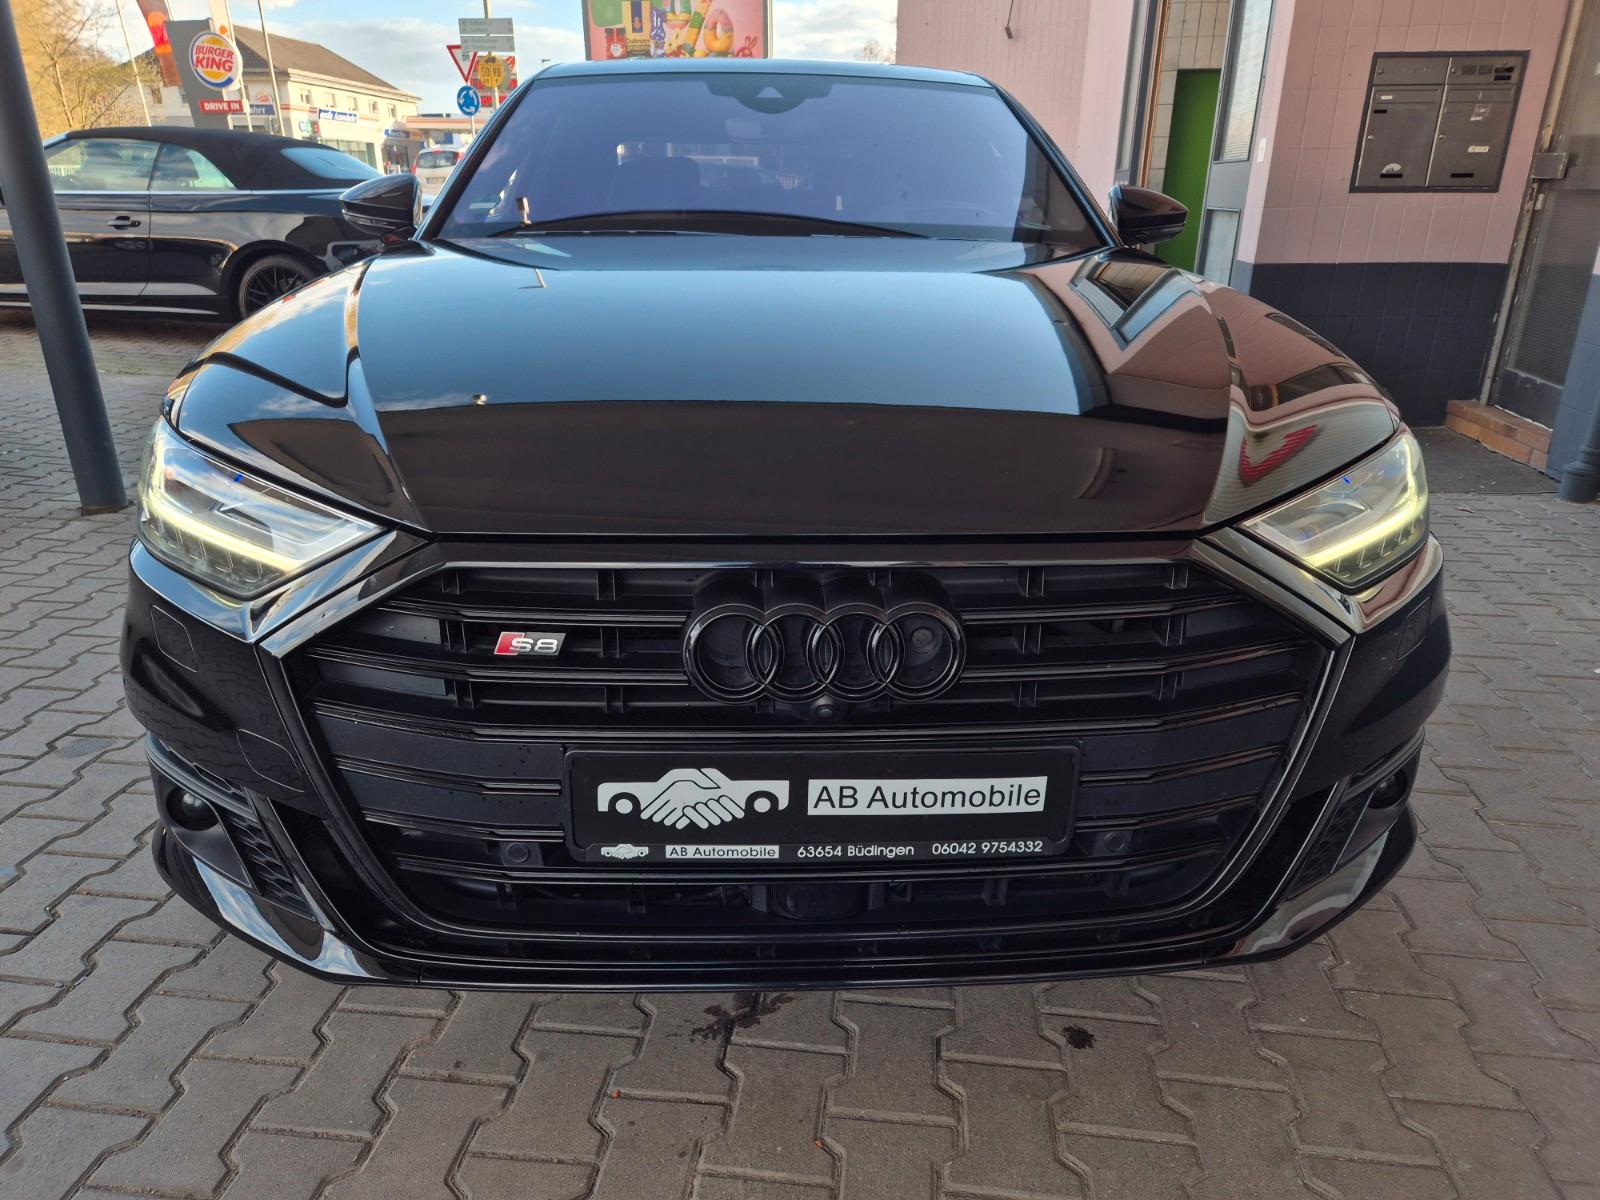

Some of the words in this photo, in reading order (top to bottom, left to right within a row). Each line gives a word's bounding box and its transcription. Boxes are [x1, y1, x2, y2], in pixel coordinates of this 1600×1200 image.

[195, 45, 234, 59] BURGER
[195, 55, 234, 73] KING
[204, 102, 229, 111] DRIVE
[230, 102, 240, 111] IN
[510, 637, 558, 653] S8
[812, 784, 858, 809] AB
[866, 781, 1042, 809] Automobile
[668, 846, 688, 858] AB
[691, 846, 777, 858] Automobile
[796, 845, 843, 858] 63654
[847, 843, 915, 860] Büdingen
[931, 842, 977, 856] 06042
[981, 841, 1043, 855] 9754332
